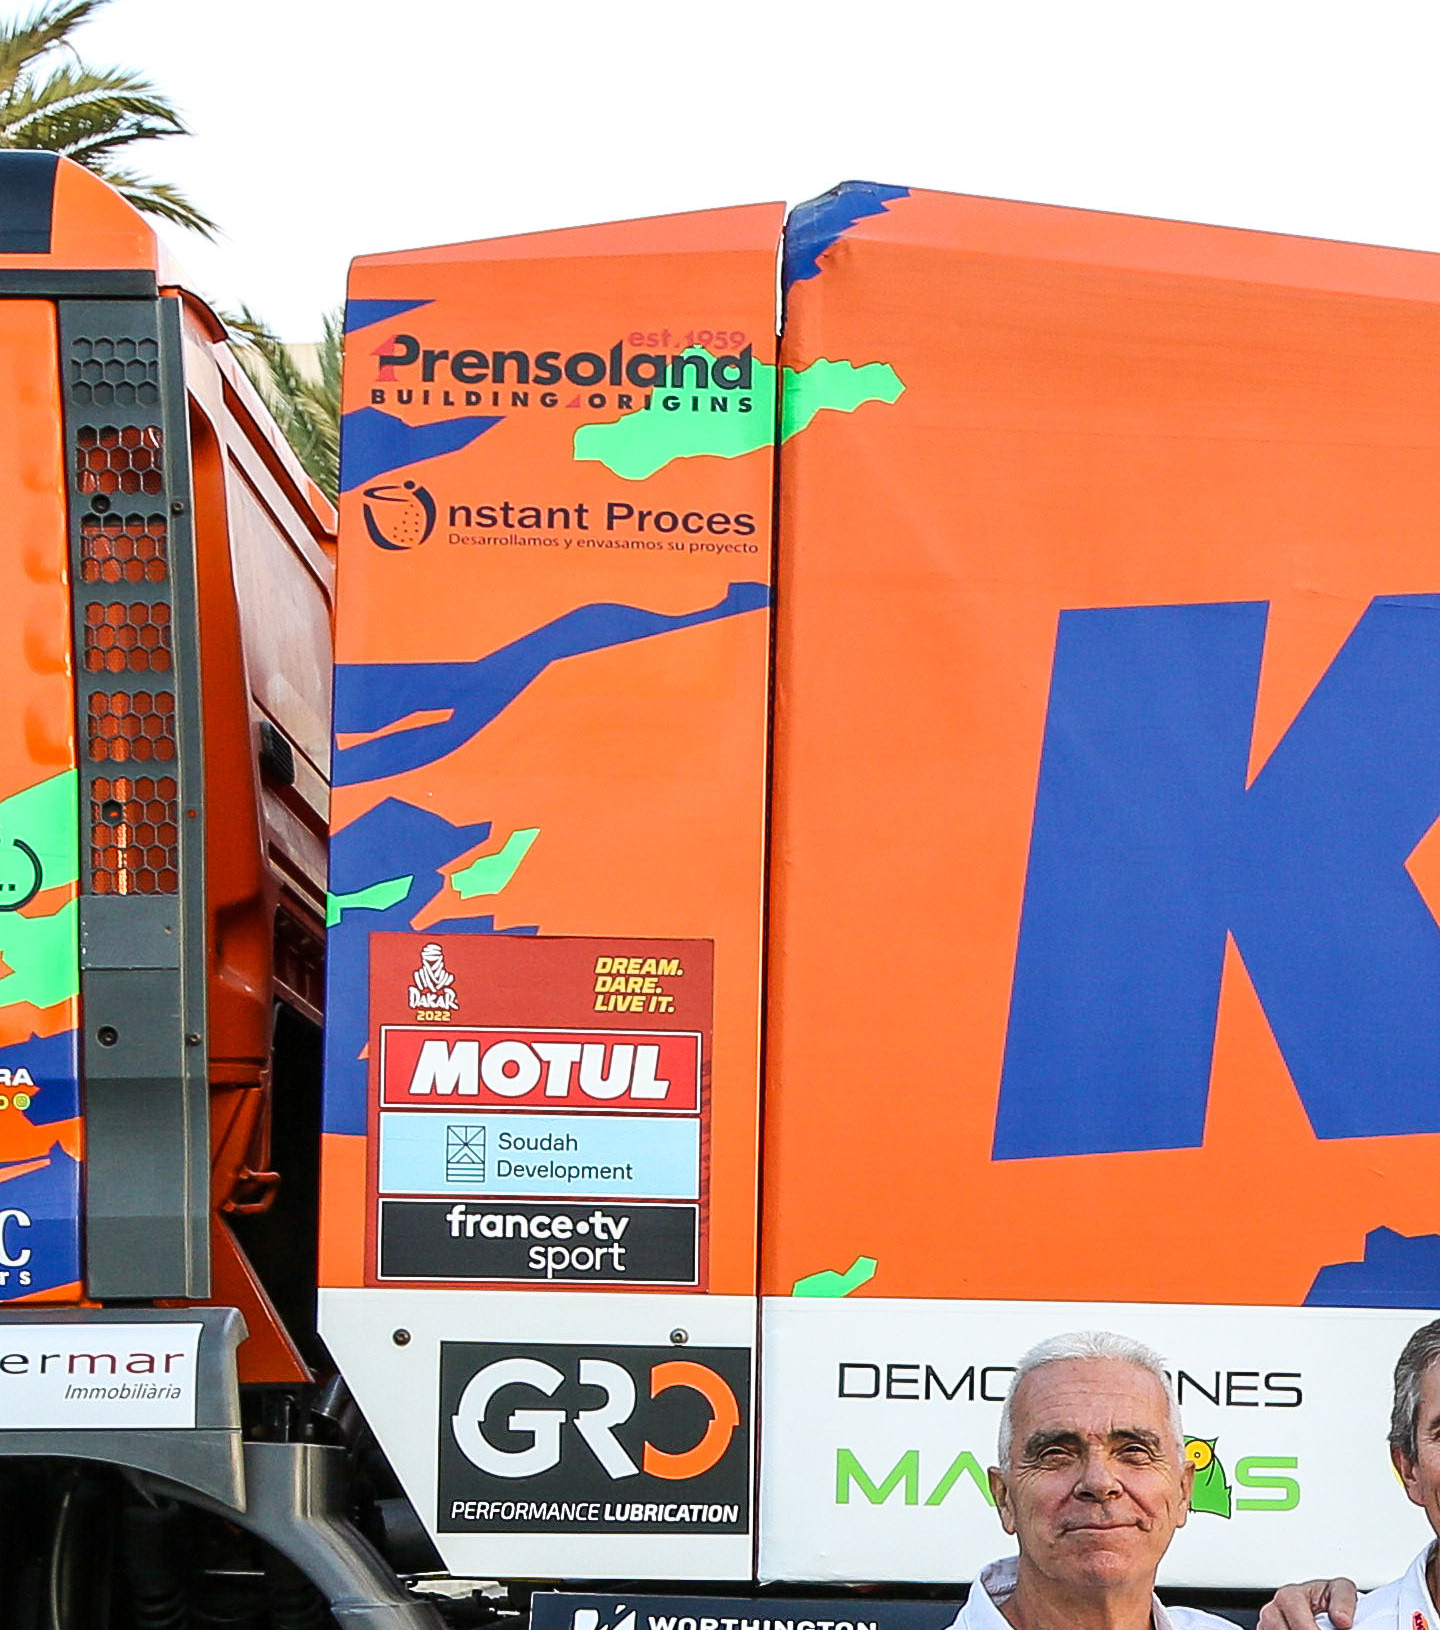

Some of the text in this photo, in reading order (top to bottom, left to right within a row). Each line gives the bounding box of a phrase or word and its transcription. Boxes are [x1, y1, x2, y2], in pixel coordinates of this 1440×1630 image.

[371, 333, 754, 391] Prensoland
[371, 388, 754, 414] BUILDING ORIGINS
[606, 502, 757, 536] Proces
[448, 532, 561, 548] Desarrollamos
[576, 538, 664, 552] envasamos
[667, 541, 687, 552] su
[689, 541, 760, 556] proyecto
[594, 957, 684, 976] DREAM.
[594, 976, 663, 994] DARE.
[408, 986, 459, 1010] DAKAR
[593, 995, 676, 1013] LIVE IT.
[416, 1010, 452, 1022] 2022
[408, 1040, 672, 1100] MOTUL
[497, 1132, 579, 1152] Soudah
[496, 1159, 634, 1184] Development
[528, 1244, 627, 1280] sport
[64, 1383, 182, 1401] Immobiliària
[451, 1499, 740, 1525] PERFORMANCE LUBRICATION
